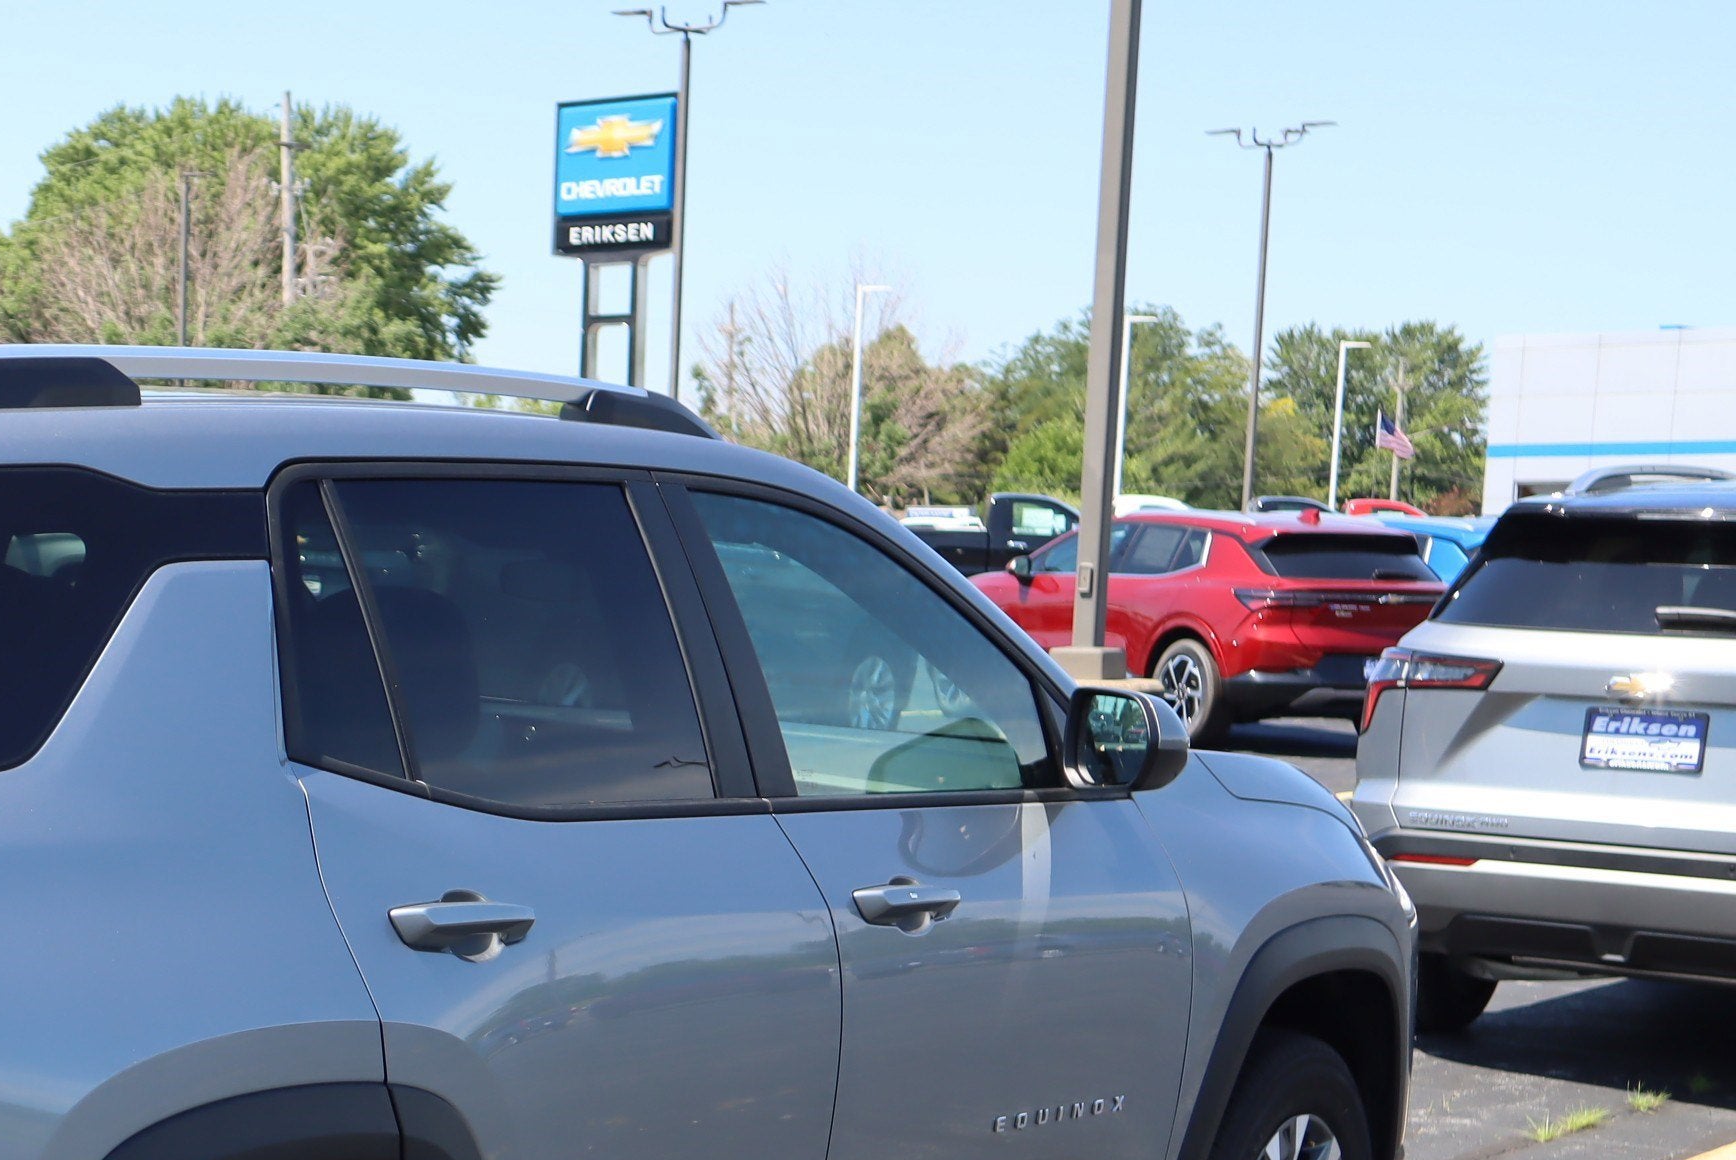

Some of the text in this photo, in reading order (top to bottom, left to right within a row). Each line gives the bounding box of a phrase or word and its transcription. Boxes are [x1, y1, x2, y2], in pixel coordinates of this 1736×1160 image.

[560, 175, 664, 201] CHEVROLET
[568, 221, 655, 246] ERIKSEN
[1592, 715, 1697, 738] Eriksen
[993, 1095, 1125, 1133] EQUINOX
